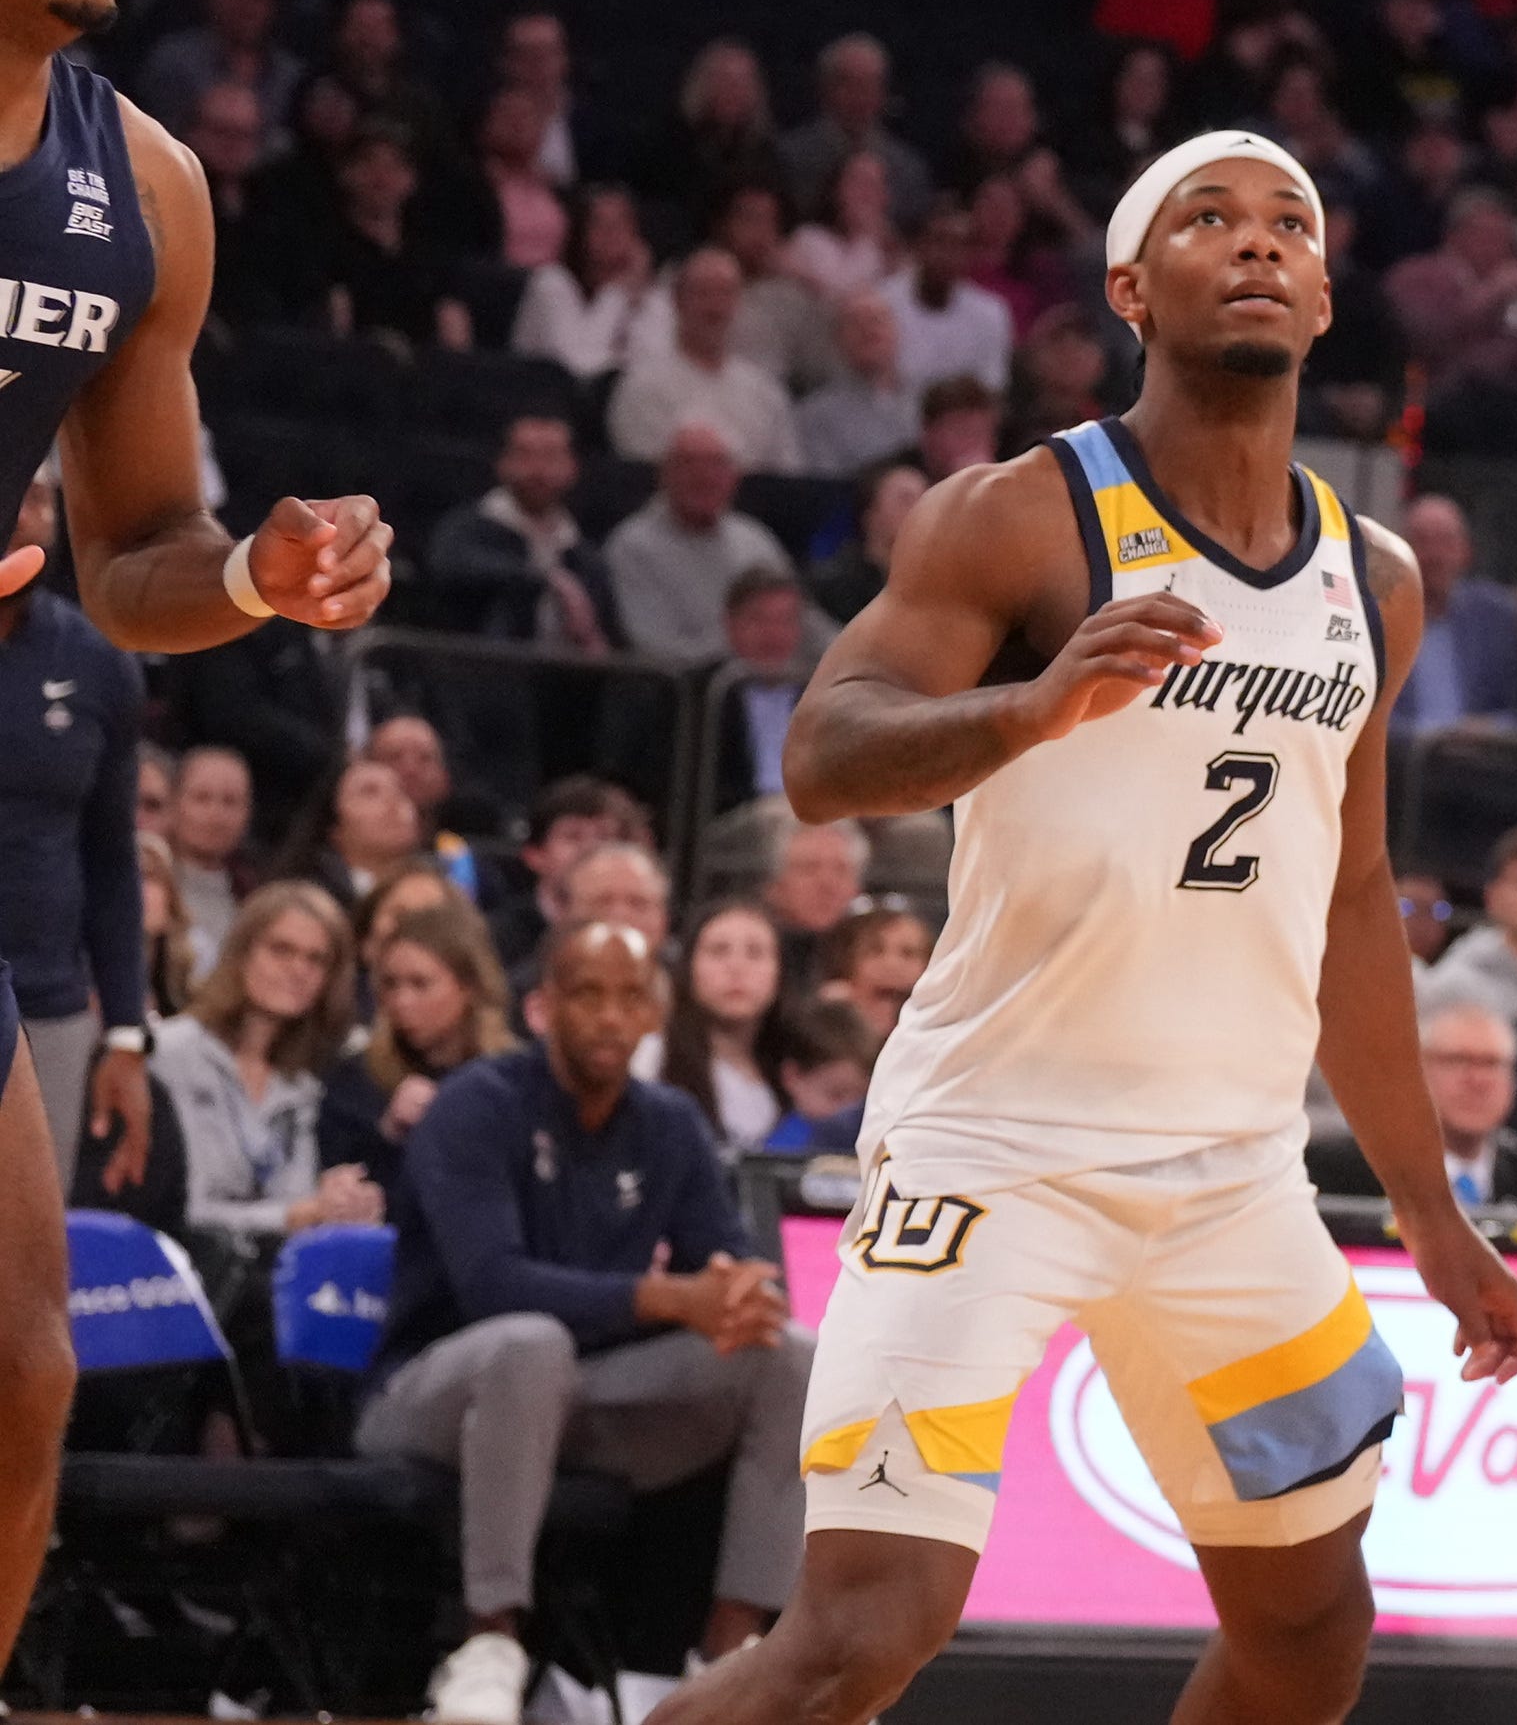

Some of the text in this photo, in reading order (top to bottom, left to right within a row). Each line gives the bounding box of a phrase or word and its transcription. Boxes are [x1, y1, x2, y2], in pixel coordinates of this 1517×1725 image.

[71, 201, 104, 221] BIG
[67, 214, 114, 237] EAST
[1118, 539, 1170, 564] CHANGE
[1326, 625, 1361, 642] EAST
[1175, 750, 1281, 894] 2
